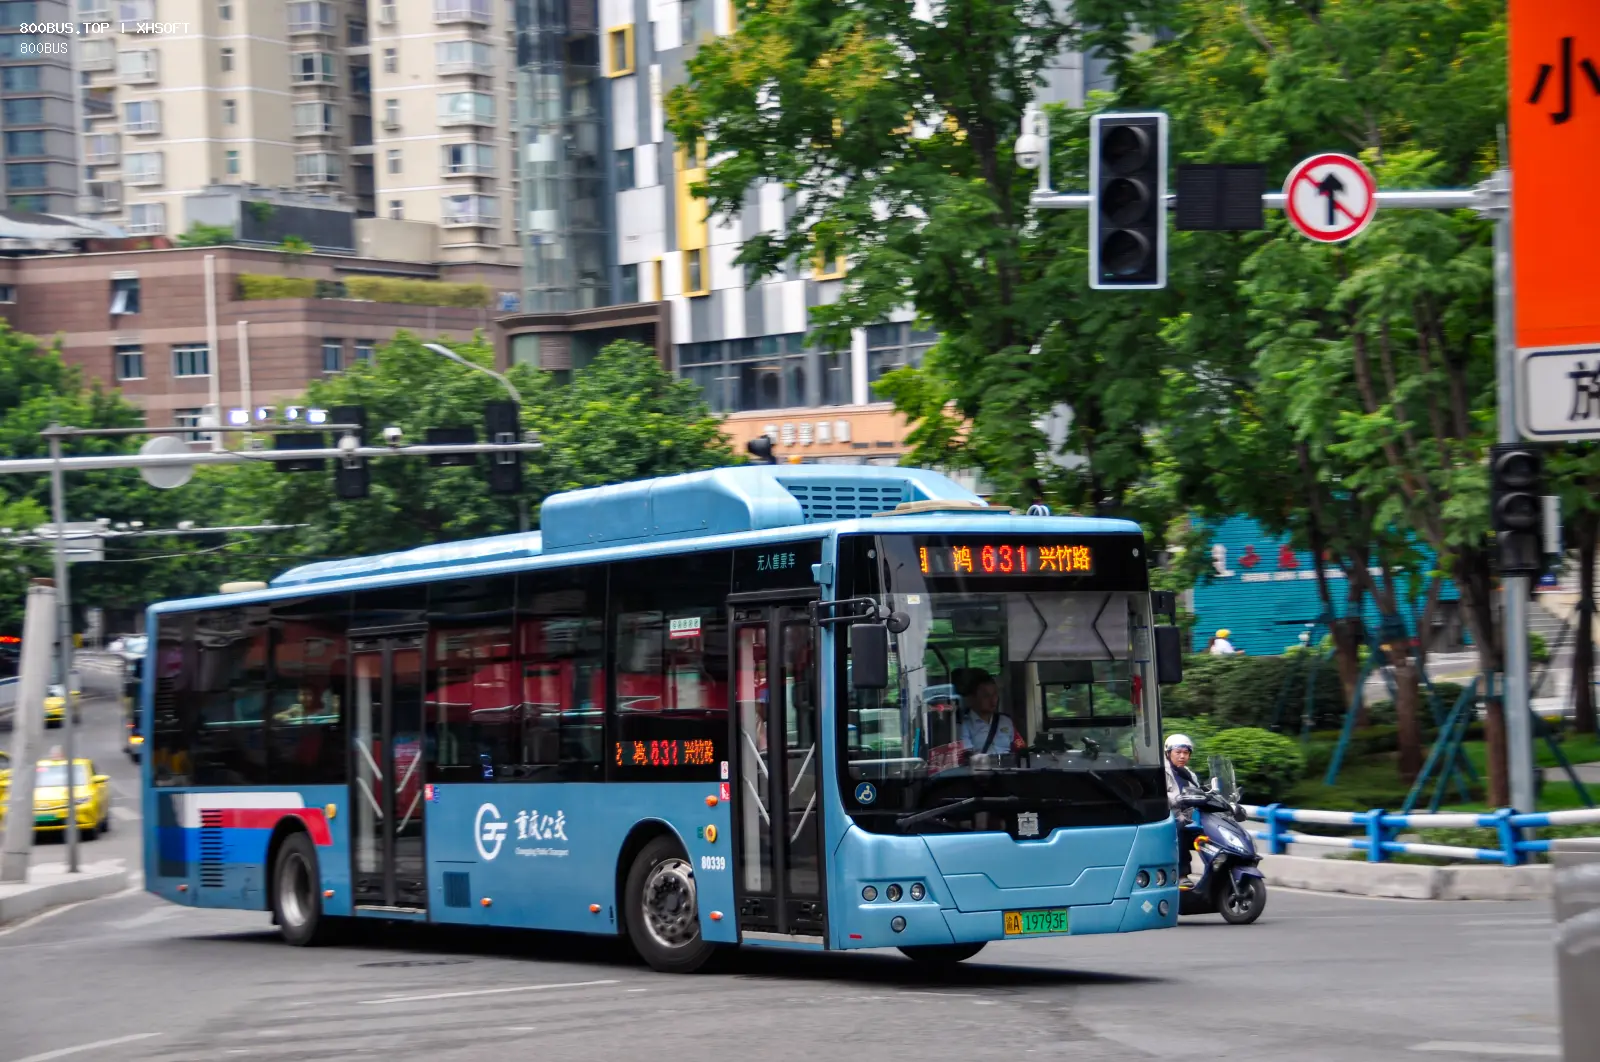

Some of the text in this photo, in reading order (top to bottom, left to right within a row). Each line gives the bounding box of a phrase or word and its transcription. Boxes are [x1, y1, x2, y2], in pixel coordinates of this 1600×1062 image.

[1526, 36, 1600, 126] 小
[757, 552, 796, 571] 无人售票车
[981, 545, 1028, 573] 631
[1039, 545, 1091, 572] 兴竹路
[701, 855, 726, 870] 80339
[1026, 912, 1065, 930] 19793F
